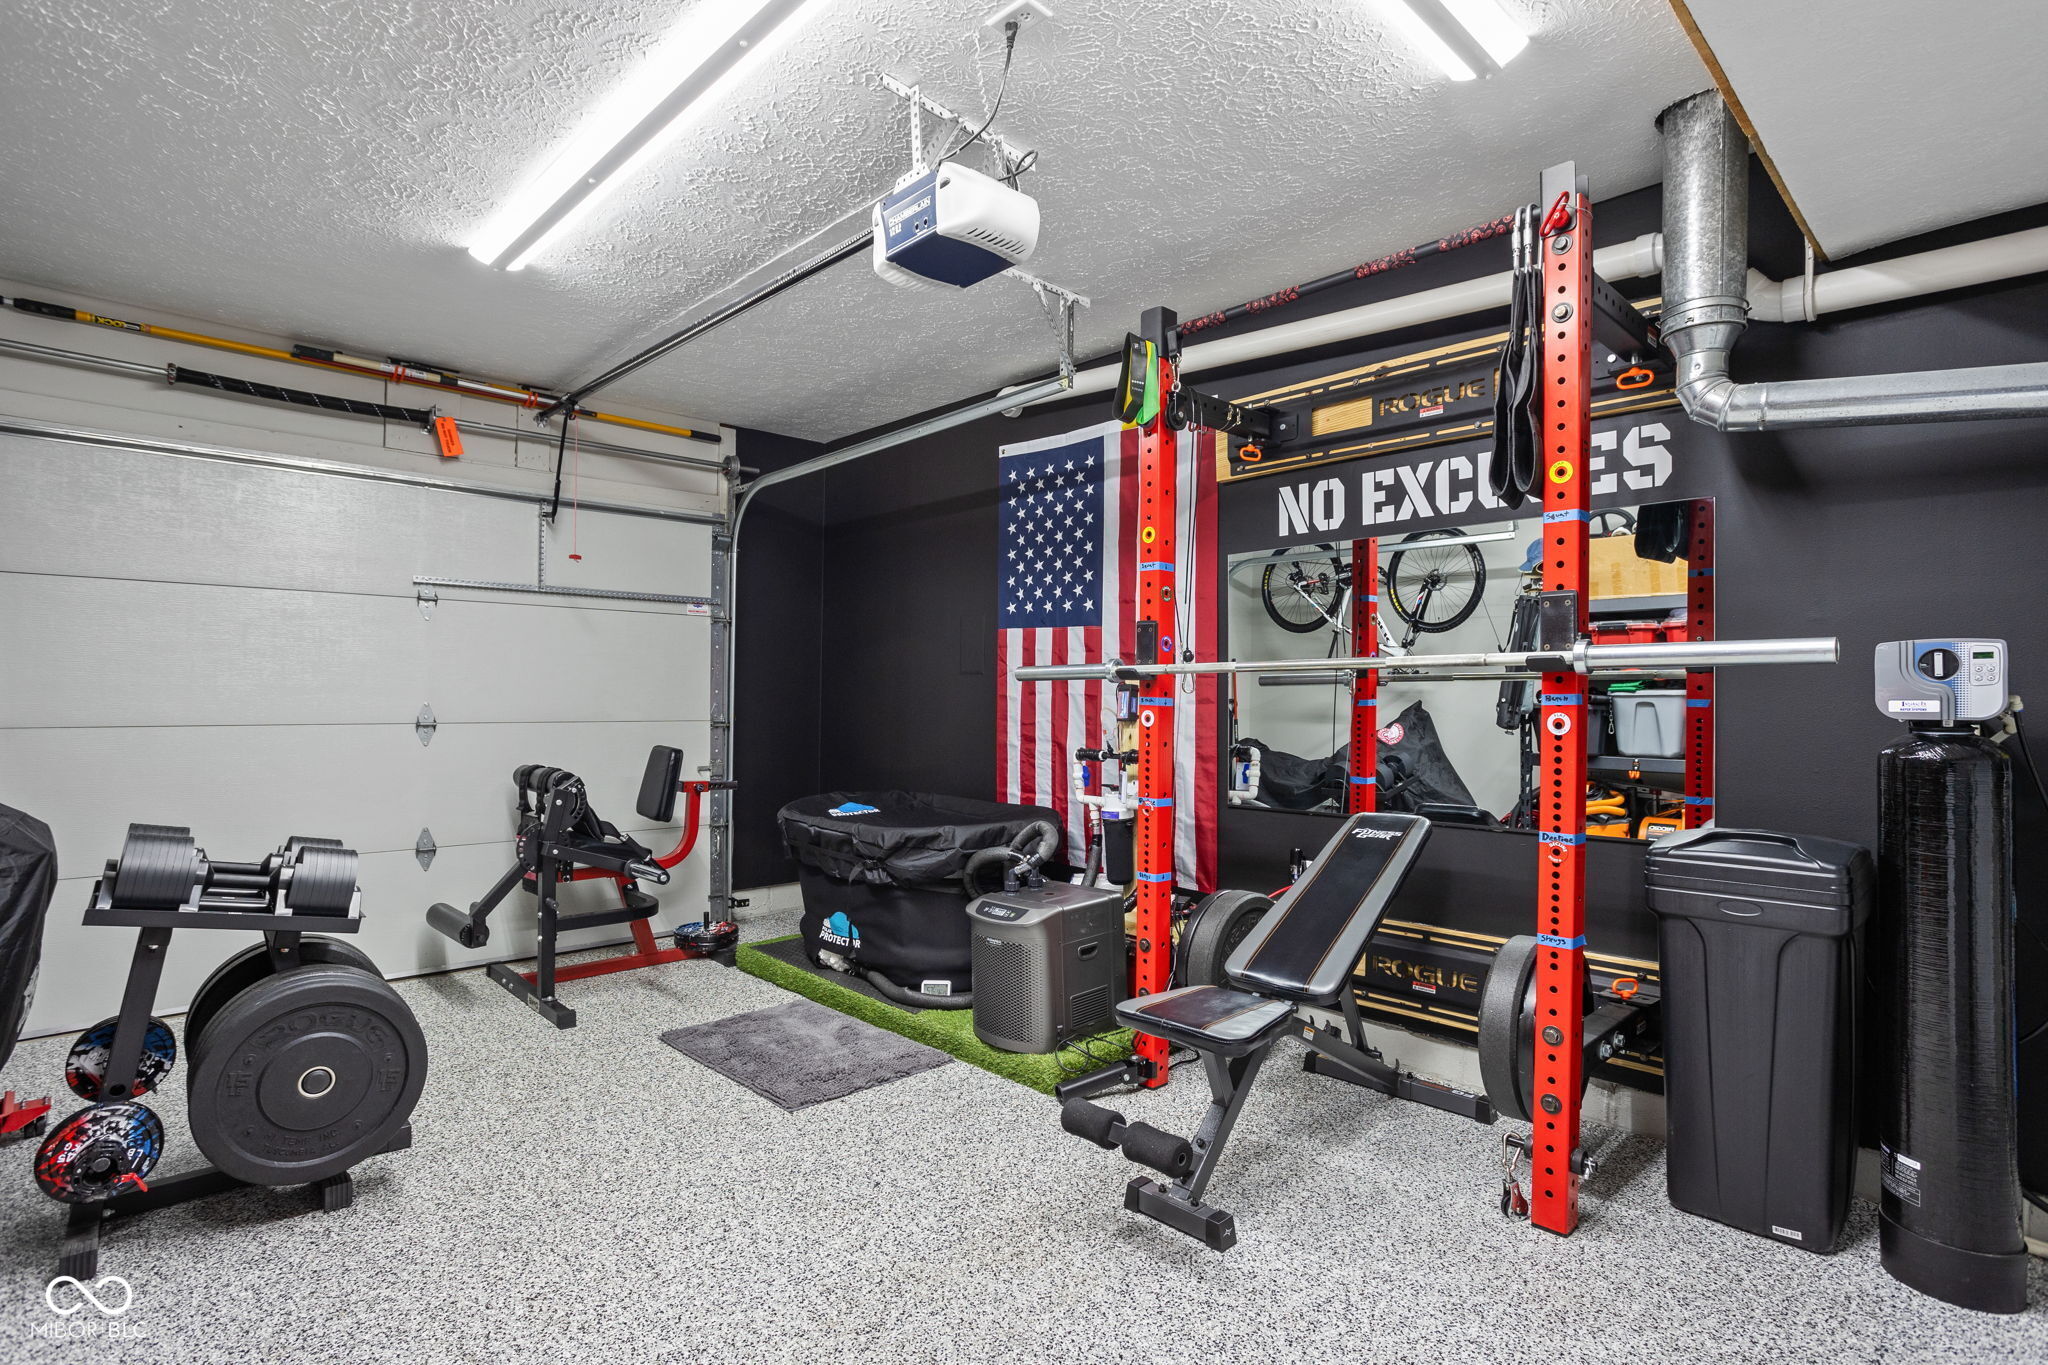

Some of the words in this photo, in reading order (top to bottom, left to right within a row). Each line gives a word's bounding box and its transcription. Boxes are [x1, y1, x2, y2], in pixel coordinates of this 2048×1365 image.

[1378, 377, 1486, 417] ROGUE
[1278, 477, 1346, 538] NO
[1362, 422, 1673, 527] EXCUES
[1372, 955, 1479, 994] ROGUE
